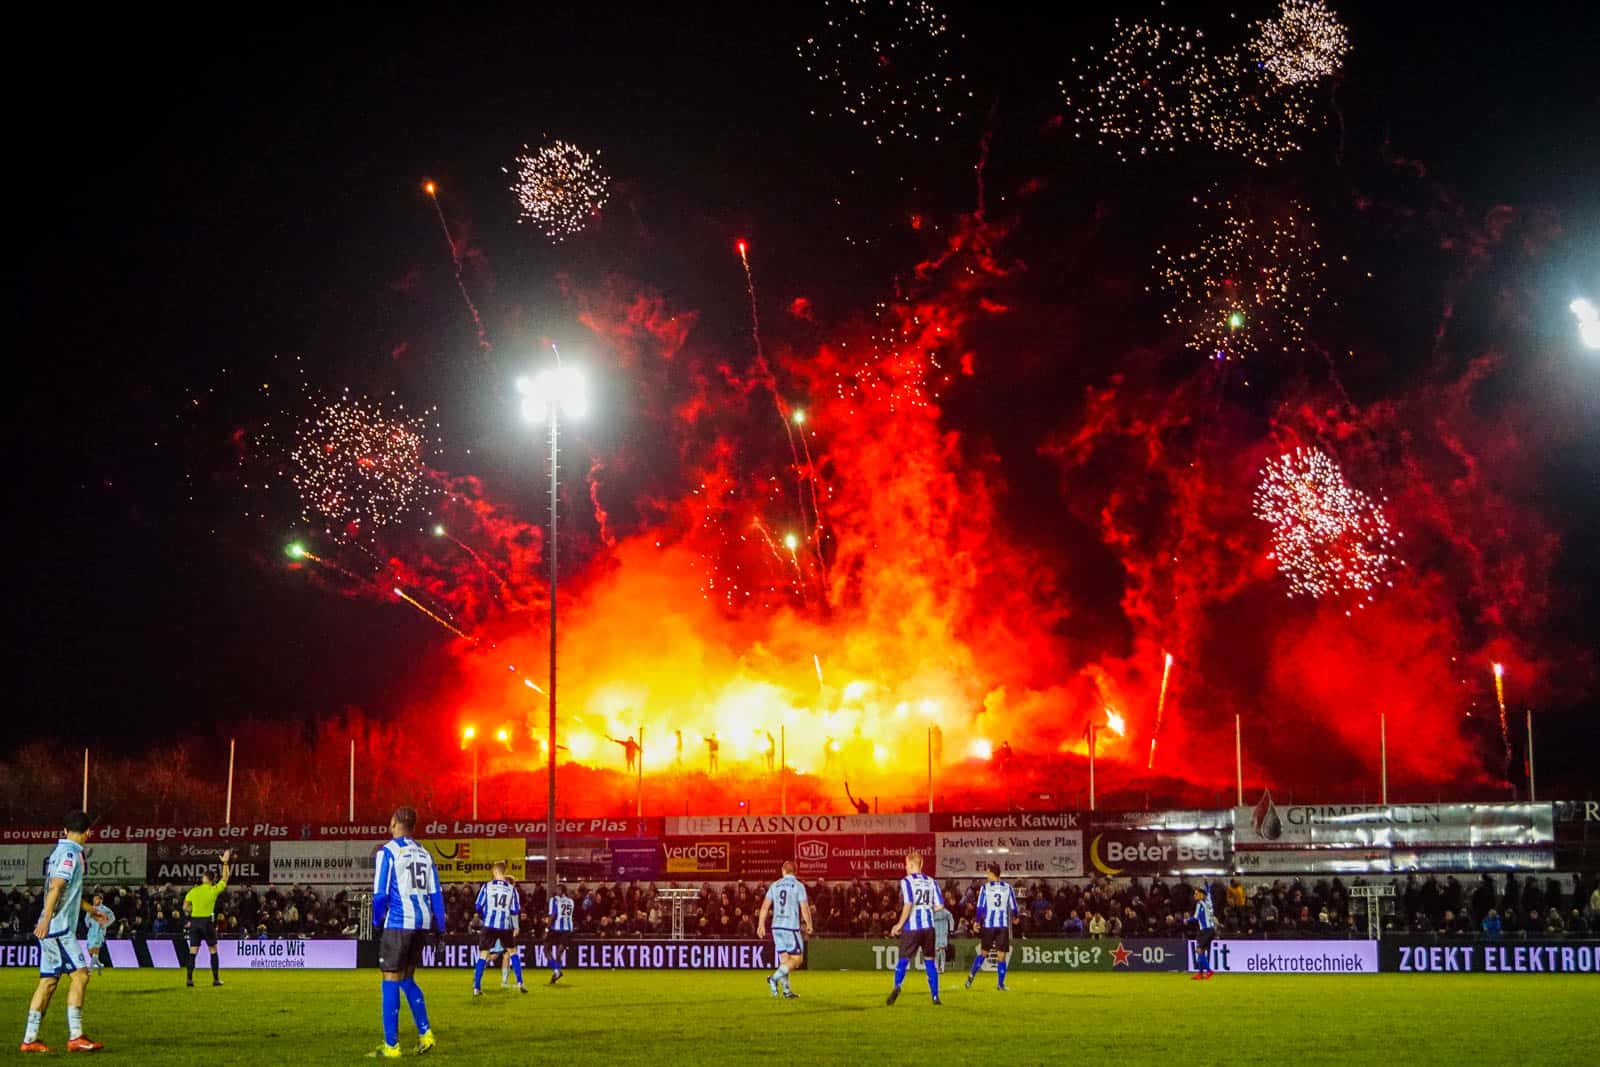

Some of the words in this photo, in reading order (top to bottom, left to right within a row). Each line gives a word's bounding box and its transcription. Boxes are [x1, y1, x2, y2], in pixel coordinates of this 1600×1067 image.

[425, 821, 448, 834] de
[454, 821, 547, 836] Lange-van
[555, 819, 585, 832] der
[590, 819, 627, 831] Plas
[719, 816, 846, 832] HAASNOOT
[952, 815, 1017, 828] Hekwerk
[1022, 813, 1077, 829] Katwijk
[100, 825, 120, 838] de
[126, 825, 213, 840] Lange-van
[219, 825, 248, 837] der
[253, 823, 288, 836] Plas
[802, 842, 825, 856] vlk
[942, 837, 994, 848] Parlevliet
[998, 838, 1006, 848] &
[1009, 837, 1030, 848] Van
[1033, 837, 1052, 847] der
[1054, 836, 1077, 847] Plas
[832, 847, 881, 857] Container
[1107, 841, 1172, 861] Beter
[1177, 841, 1225, 861] Bed
[273, 857, 292, 868] VAN
[294, 857, 322, 868] RHIJN
[324, 857, 353, 868] BOUW
[456, 860, 508, 873] Egmo
[1004, 860, 1022, 871] for
[1025, 860, 1044, 871] life
[406, 862, 428, 890] 15
[492, 893, 508, 908] 14
[779, 890, 787, 906] 9
[915, 888, 930, 906] 24
[993, 893, 1002, 907] 3
[560, 903, 573, 916] 25
[237, 940, 266, 956] Henk
[269, 940, 284, 956] de
[286, 940, 305, 956] Wit
[250, 959, 305, 968] elektrotechniek
[1021, 946, 1101, 967] Biertje?
[1247, 953, 1363, 972] elektrotechniek
[1399, 947, 1474, 972] ZOEKT
